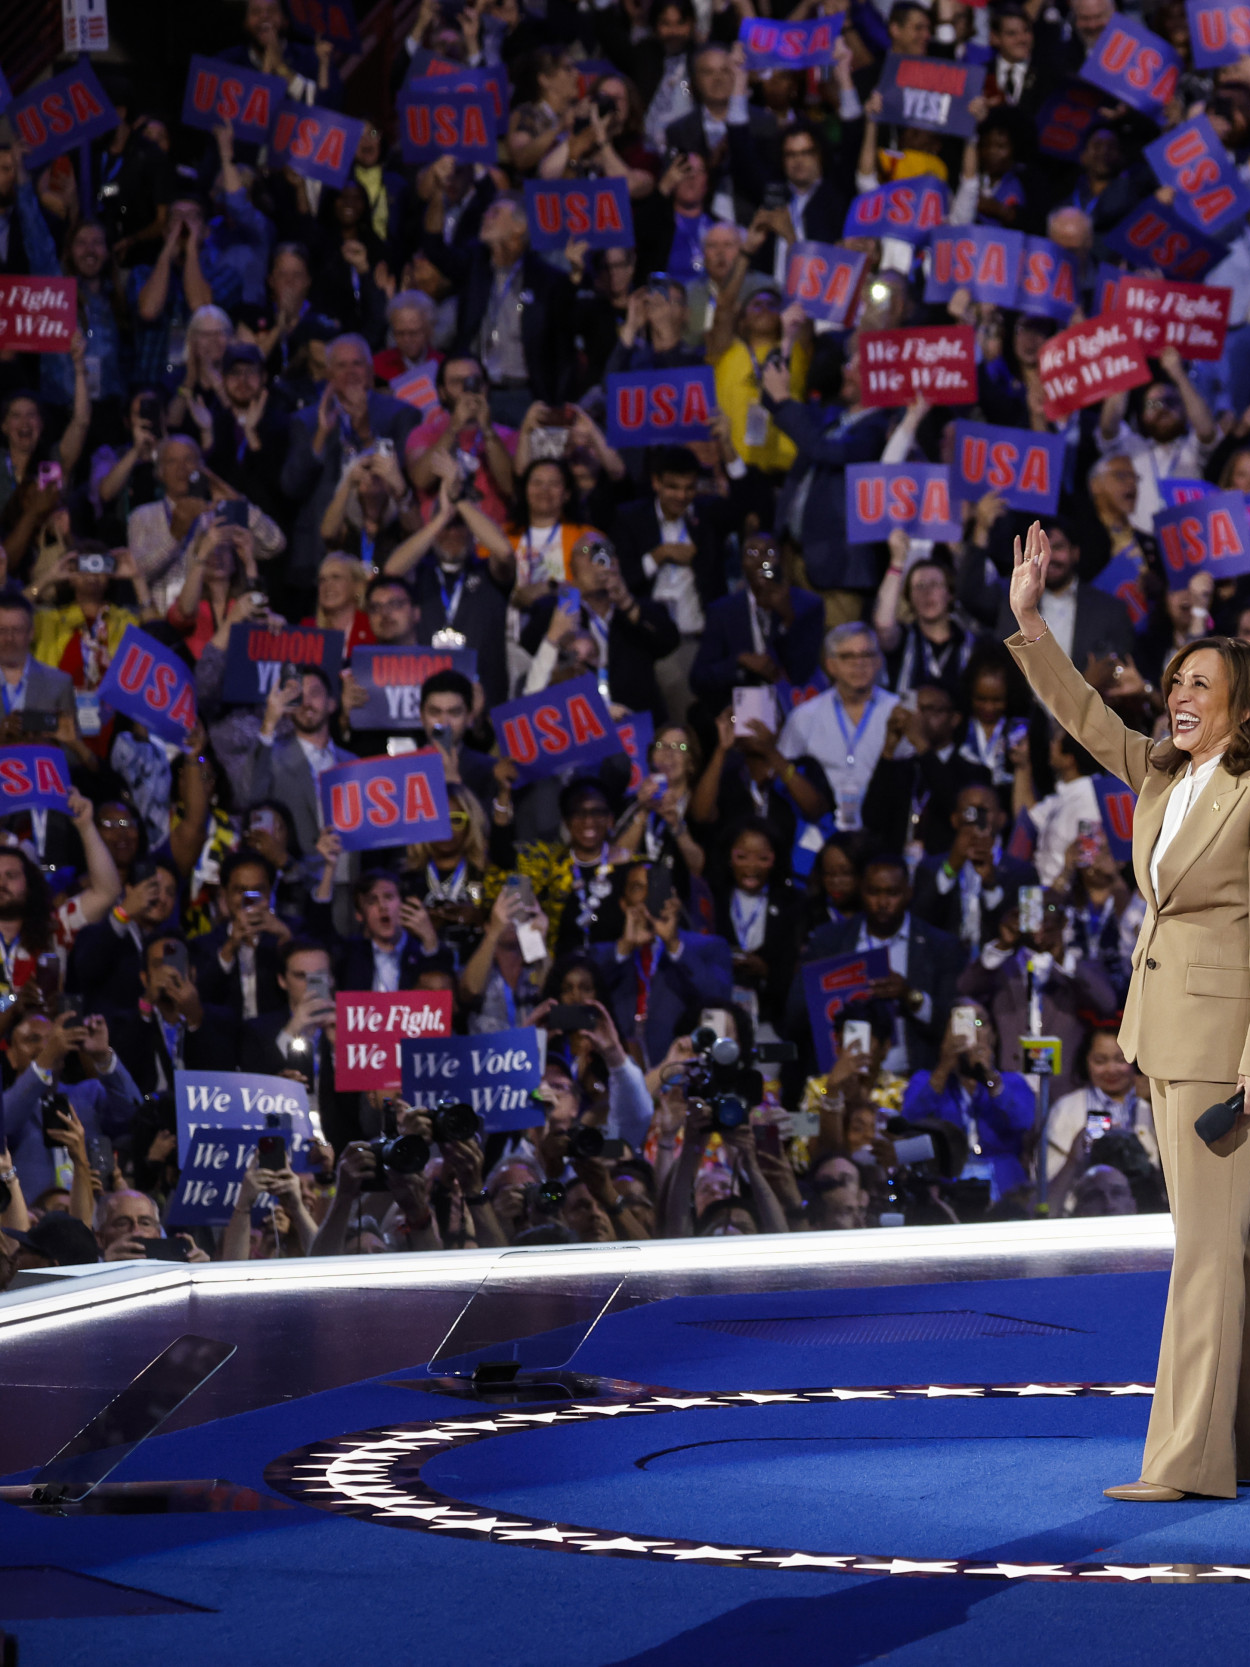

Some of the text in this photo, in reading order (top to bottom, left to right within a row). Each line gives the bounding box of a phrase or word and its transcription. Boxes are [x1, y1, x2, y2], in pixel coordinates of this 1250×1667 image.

[749, 24, 834, 58] USA
[1100, 29, 1179, 106] USA
[17, 81, 103, 147] USA
[193, 71, 271, 127] USA
[903, 87, 951, 125] YES!
[273, 112, 348, 169] USA
[406, 105, 488, 147] USA
[1164, 128, 1236, 224] USA
[535, 191, 623, 234] USA
[857, 188, 946, 228] USA
[934, 240, 1009, 286] USA
[1024, 250, 1074, 299] SA
[617, 381, 711, 428] USA
[963, 437, 1051, 494] USA
[856, 476, 951, 524] USA
[1160, 508, 1244, 571] USA
[248, 629, 325, 664] UNION
[118, 643, 196, 729] USA
[501, 693, 606, 766] USA
[0, 756, 67, 796] SA
[330, 771, 439, 832] USA
[345, 1004, 446, 1038] We Fight,
[346, 1043, 386, 1070] We
[412, 1051, 461, 1079] We
[469, 1051, 531, 1079] Vote,
[186, 1085, 304, 1118] We Vote,
[193, 1144, 240, 1170] We
[182, 1180, 228, 1207] We
